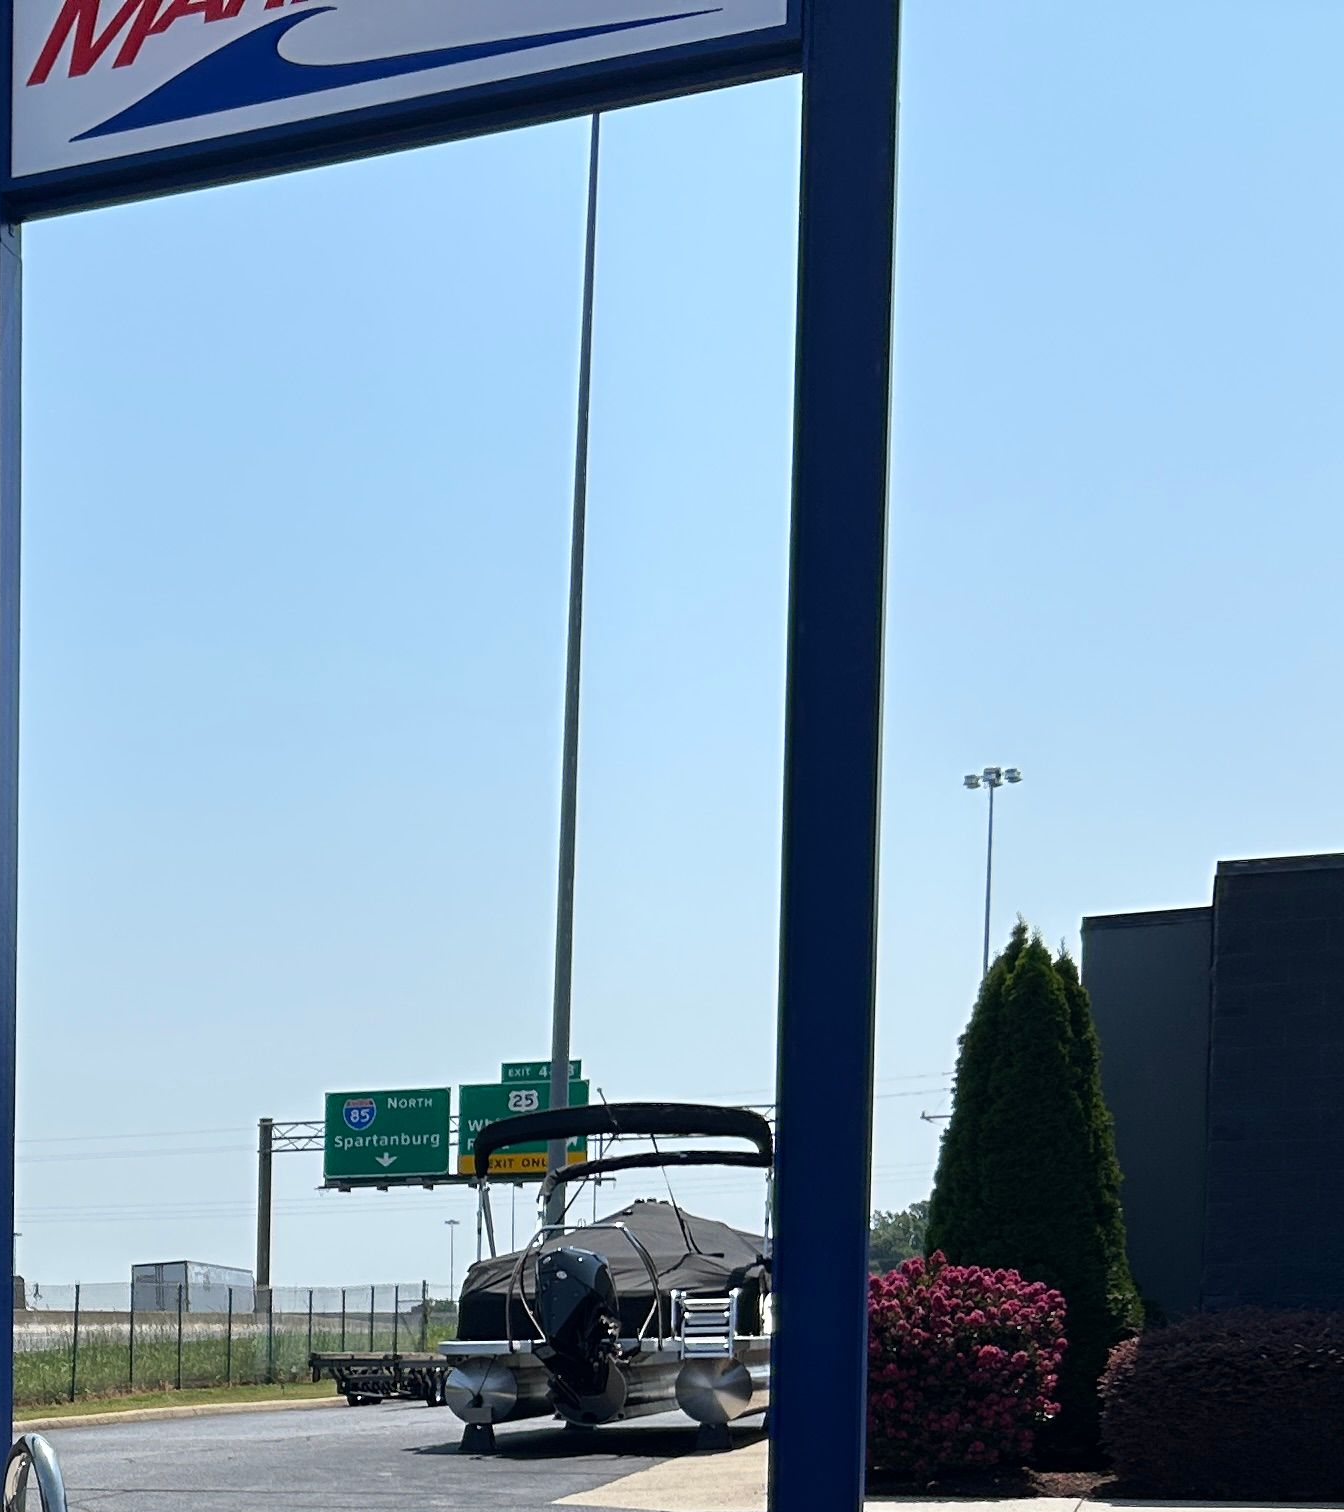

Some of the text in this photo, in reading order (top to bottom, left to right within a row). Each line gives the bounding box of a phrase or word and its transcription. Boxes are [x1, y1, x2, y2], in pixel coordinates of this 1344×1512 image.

[508, 1066, 531, 1078] EXIT
[387, 1097, 433, 1109] NORTH
[513, 1093, 535, 1108] 25
[350, 1109, 371, 1122] 85
[334, 1133, 440, 1151] Spartanburg
